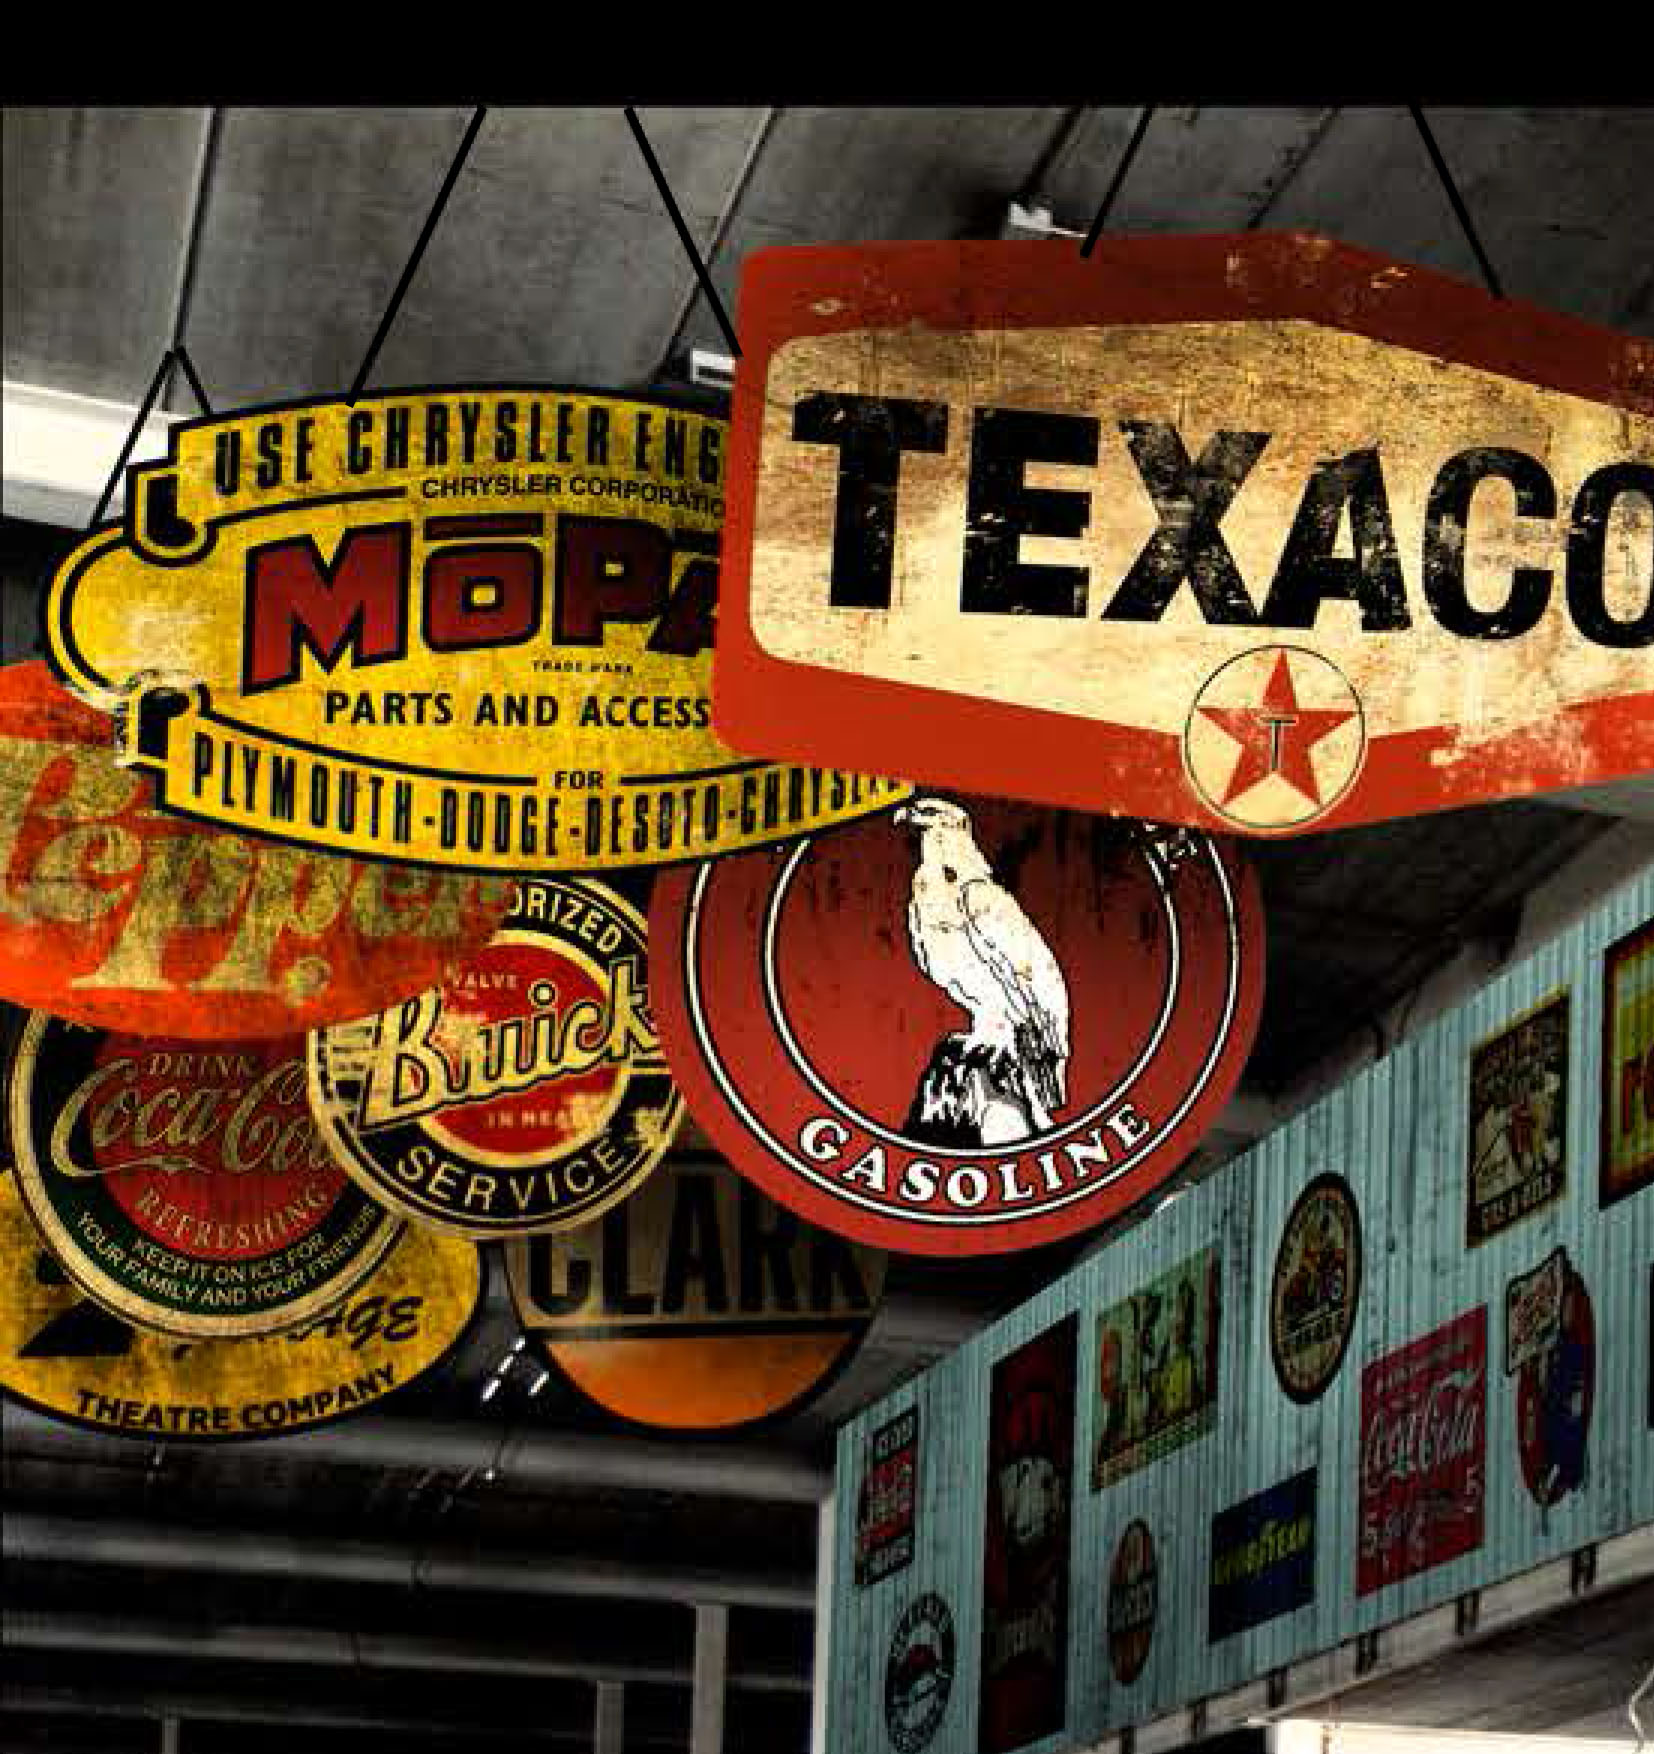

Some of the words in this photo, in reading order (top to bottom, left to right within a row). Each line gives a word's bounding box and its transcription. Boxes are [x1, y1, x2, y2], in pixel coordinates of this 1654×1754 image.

[214, 417, 315, 497] USE
[346, 400, 611, 475] CHRYSLER
[422, 475, 562, 500] CHRYSLER
[325, 690, 454, 727] PARTS
[474, 691, 559, 727] AND
[579, 694, 711, 728] ACCESS
[554, 769, 604, 791] FOR
[148, 1052, 256, 1078] DRINK
[360, 957, 661, 1132] Buick
[399, 1137, 628, 1211] SERVICE
[799, 1102, 1154, 1209] GASOLINE
[138, 1185, 329, 1251] REFRESHING
[76, 1210, 126, 1268] YOUR
[126, 1257, 199, 1301] FAMILY
[200, 1286, 248, 1306] AND
[250, 1270, 305, 1303] YOUR
[135, 1238, 191, 1279] KEEP
[191, 1263, 210, 1282] IT
[213, 1264, 246, 1284] ON
[249, 1257, 283, 1281] ICE
[287, 1232, 325, 1268] FOR
[77, 1388, 230, 1431] THEATRE
[243, 1364, 395, 1430] COMPANY
